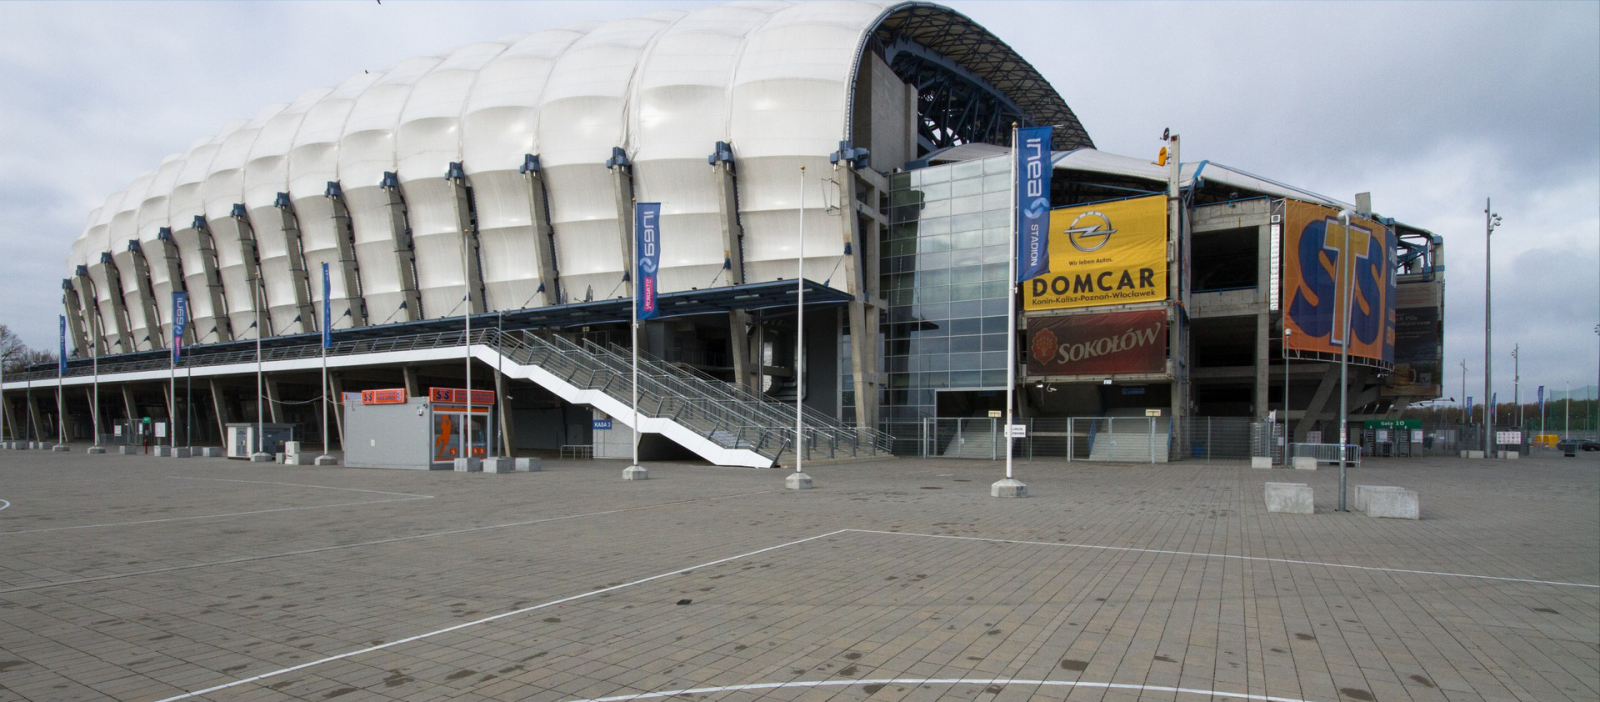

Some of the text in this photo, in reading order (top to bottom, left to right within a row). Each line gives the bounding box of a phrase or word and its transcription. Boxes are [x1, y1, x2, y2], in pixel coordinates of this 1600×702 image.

[1027, 138, 1042, 197] inea
[1030, 224, 1039, 266] STADION
[1032, 268, 1155, 297] DOMCAR
[1289, 215, 1384, 346] STS
[1058, 322, 1161, 364] SOKOŁÓW
